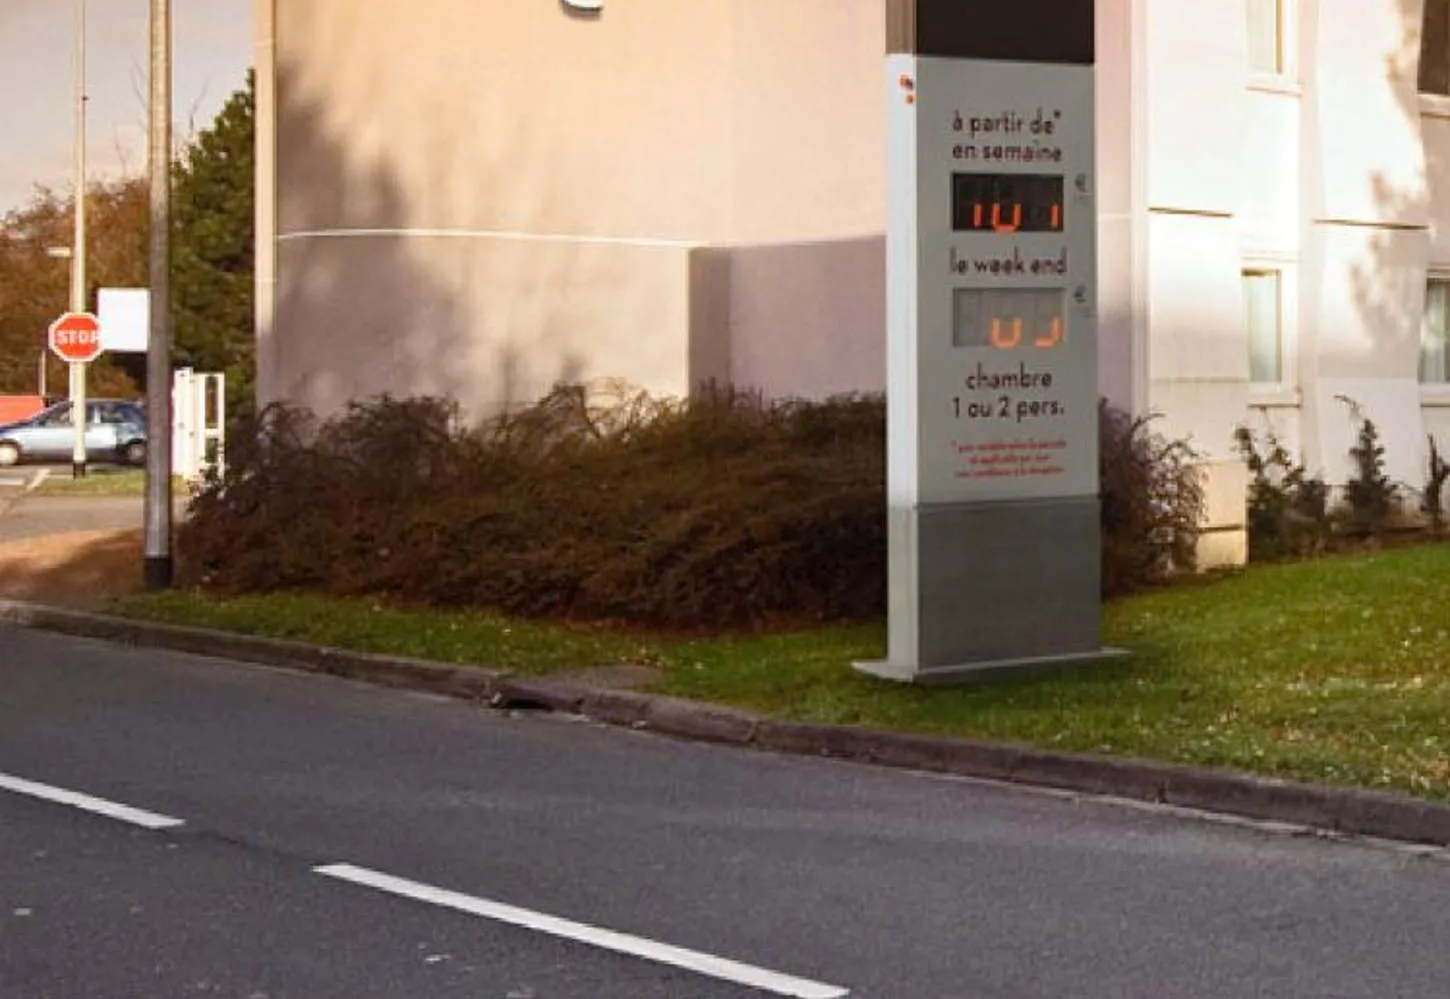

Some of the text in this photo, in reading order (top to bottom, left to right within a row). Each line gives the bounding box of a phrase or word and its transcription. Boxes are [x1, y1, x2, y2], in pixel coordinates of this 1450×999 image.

[970, 110, 1022, 138] partir
[952, 142, 1062, 162] en semaine
[951, 247, 968, 274] le
[56, 329, 101, 345] STOP
[965, 361, 1053, 391] chambre
[953, 397, 1065, 424] 1 ou 2 pers.
